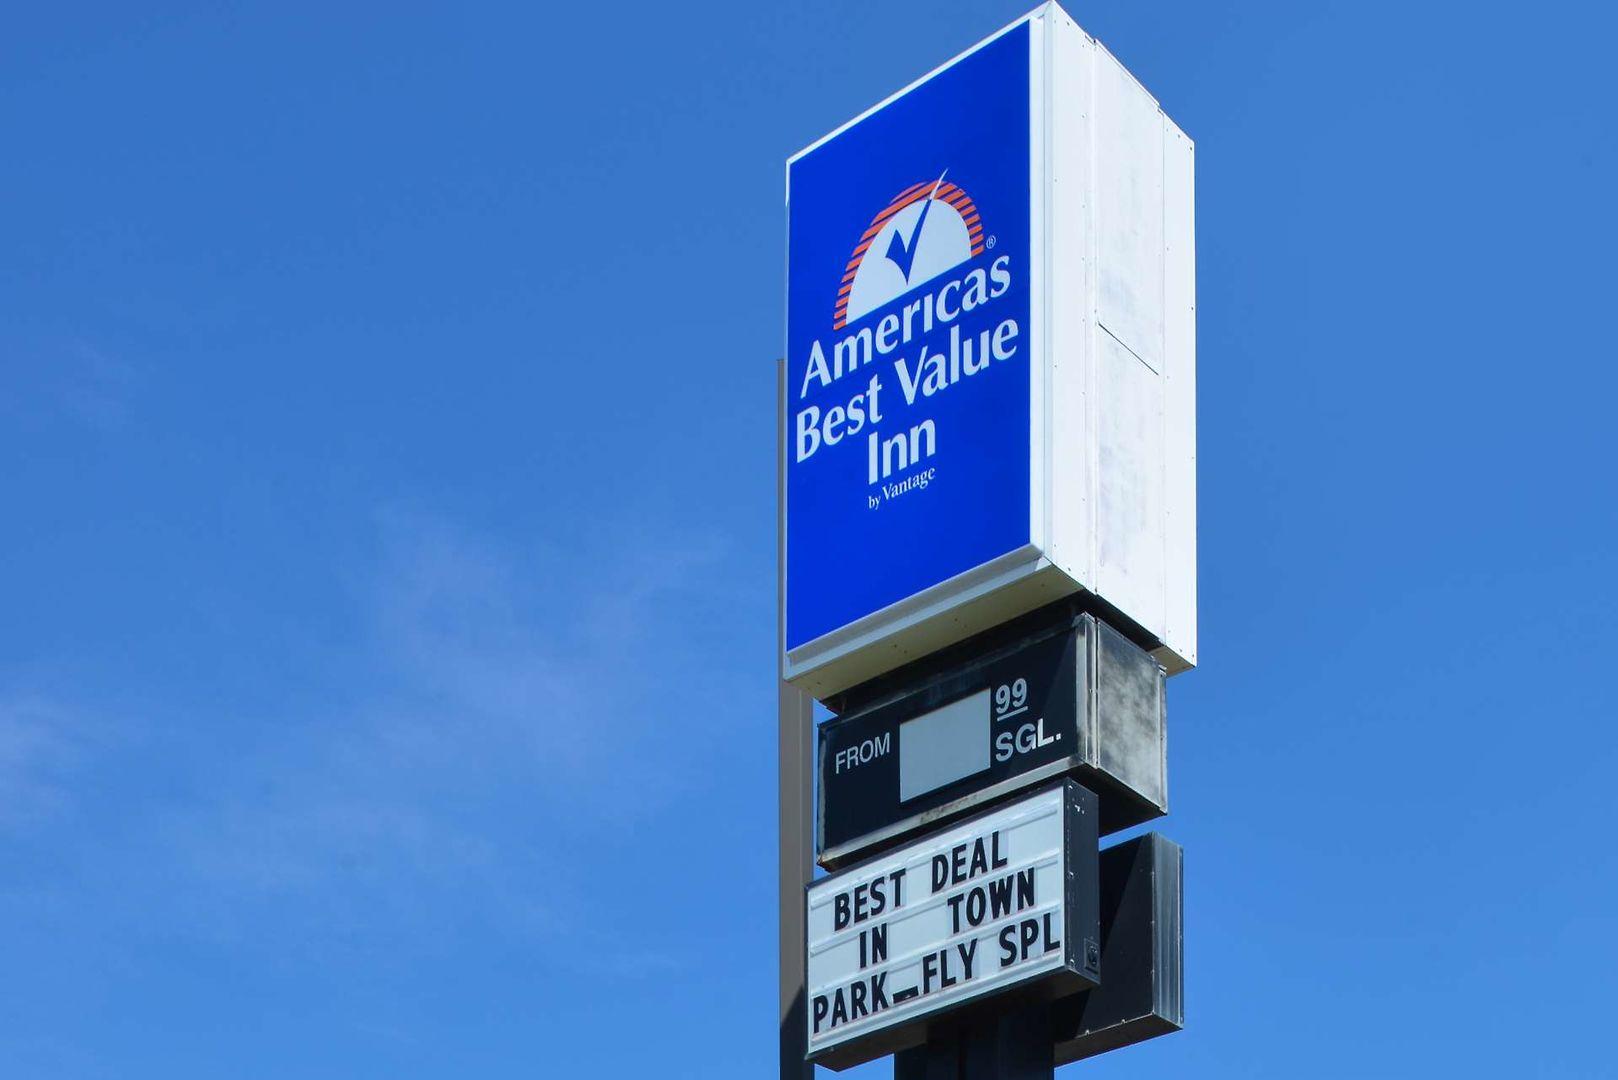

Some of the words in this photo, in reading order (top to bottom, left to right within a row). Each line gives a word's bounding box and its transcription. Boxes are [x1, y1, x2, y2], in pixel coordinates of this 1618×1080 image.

[800, 254, 1011, 399] Americas
[796, 373, 883, 463] Best
[894, 318, 1019, 406] Value
[868, 419, 936, 485] Inn
[868, 494, 882, 510] by
[882, 466, 936, 500] Vantage
[995, 677, 1029, 715] 99
[835, 732, 891, 775] FROM
[995, 718, 1062, 762] SGL.
[834, 868, 906, 932] BEST
[931, 831, 1008, 893] DEAL
[859, 922, 888, 969] IN
[947, 867, 1035, 934] TOWN
[999, 912, 1061, 967] SPL
